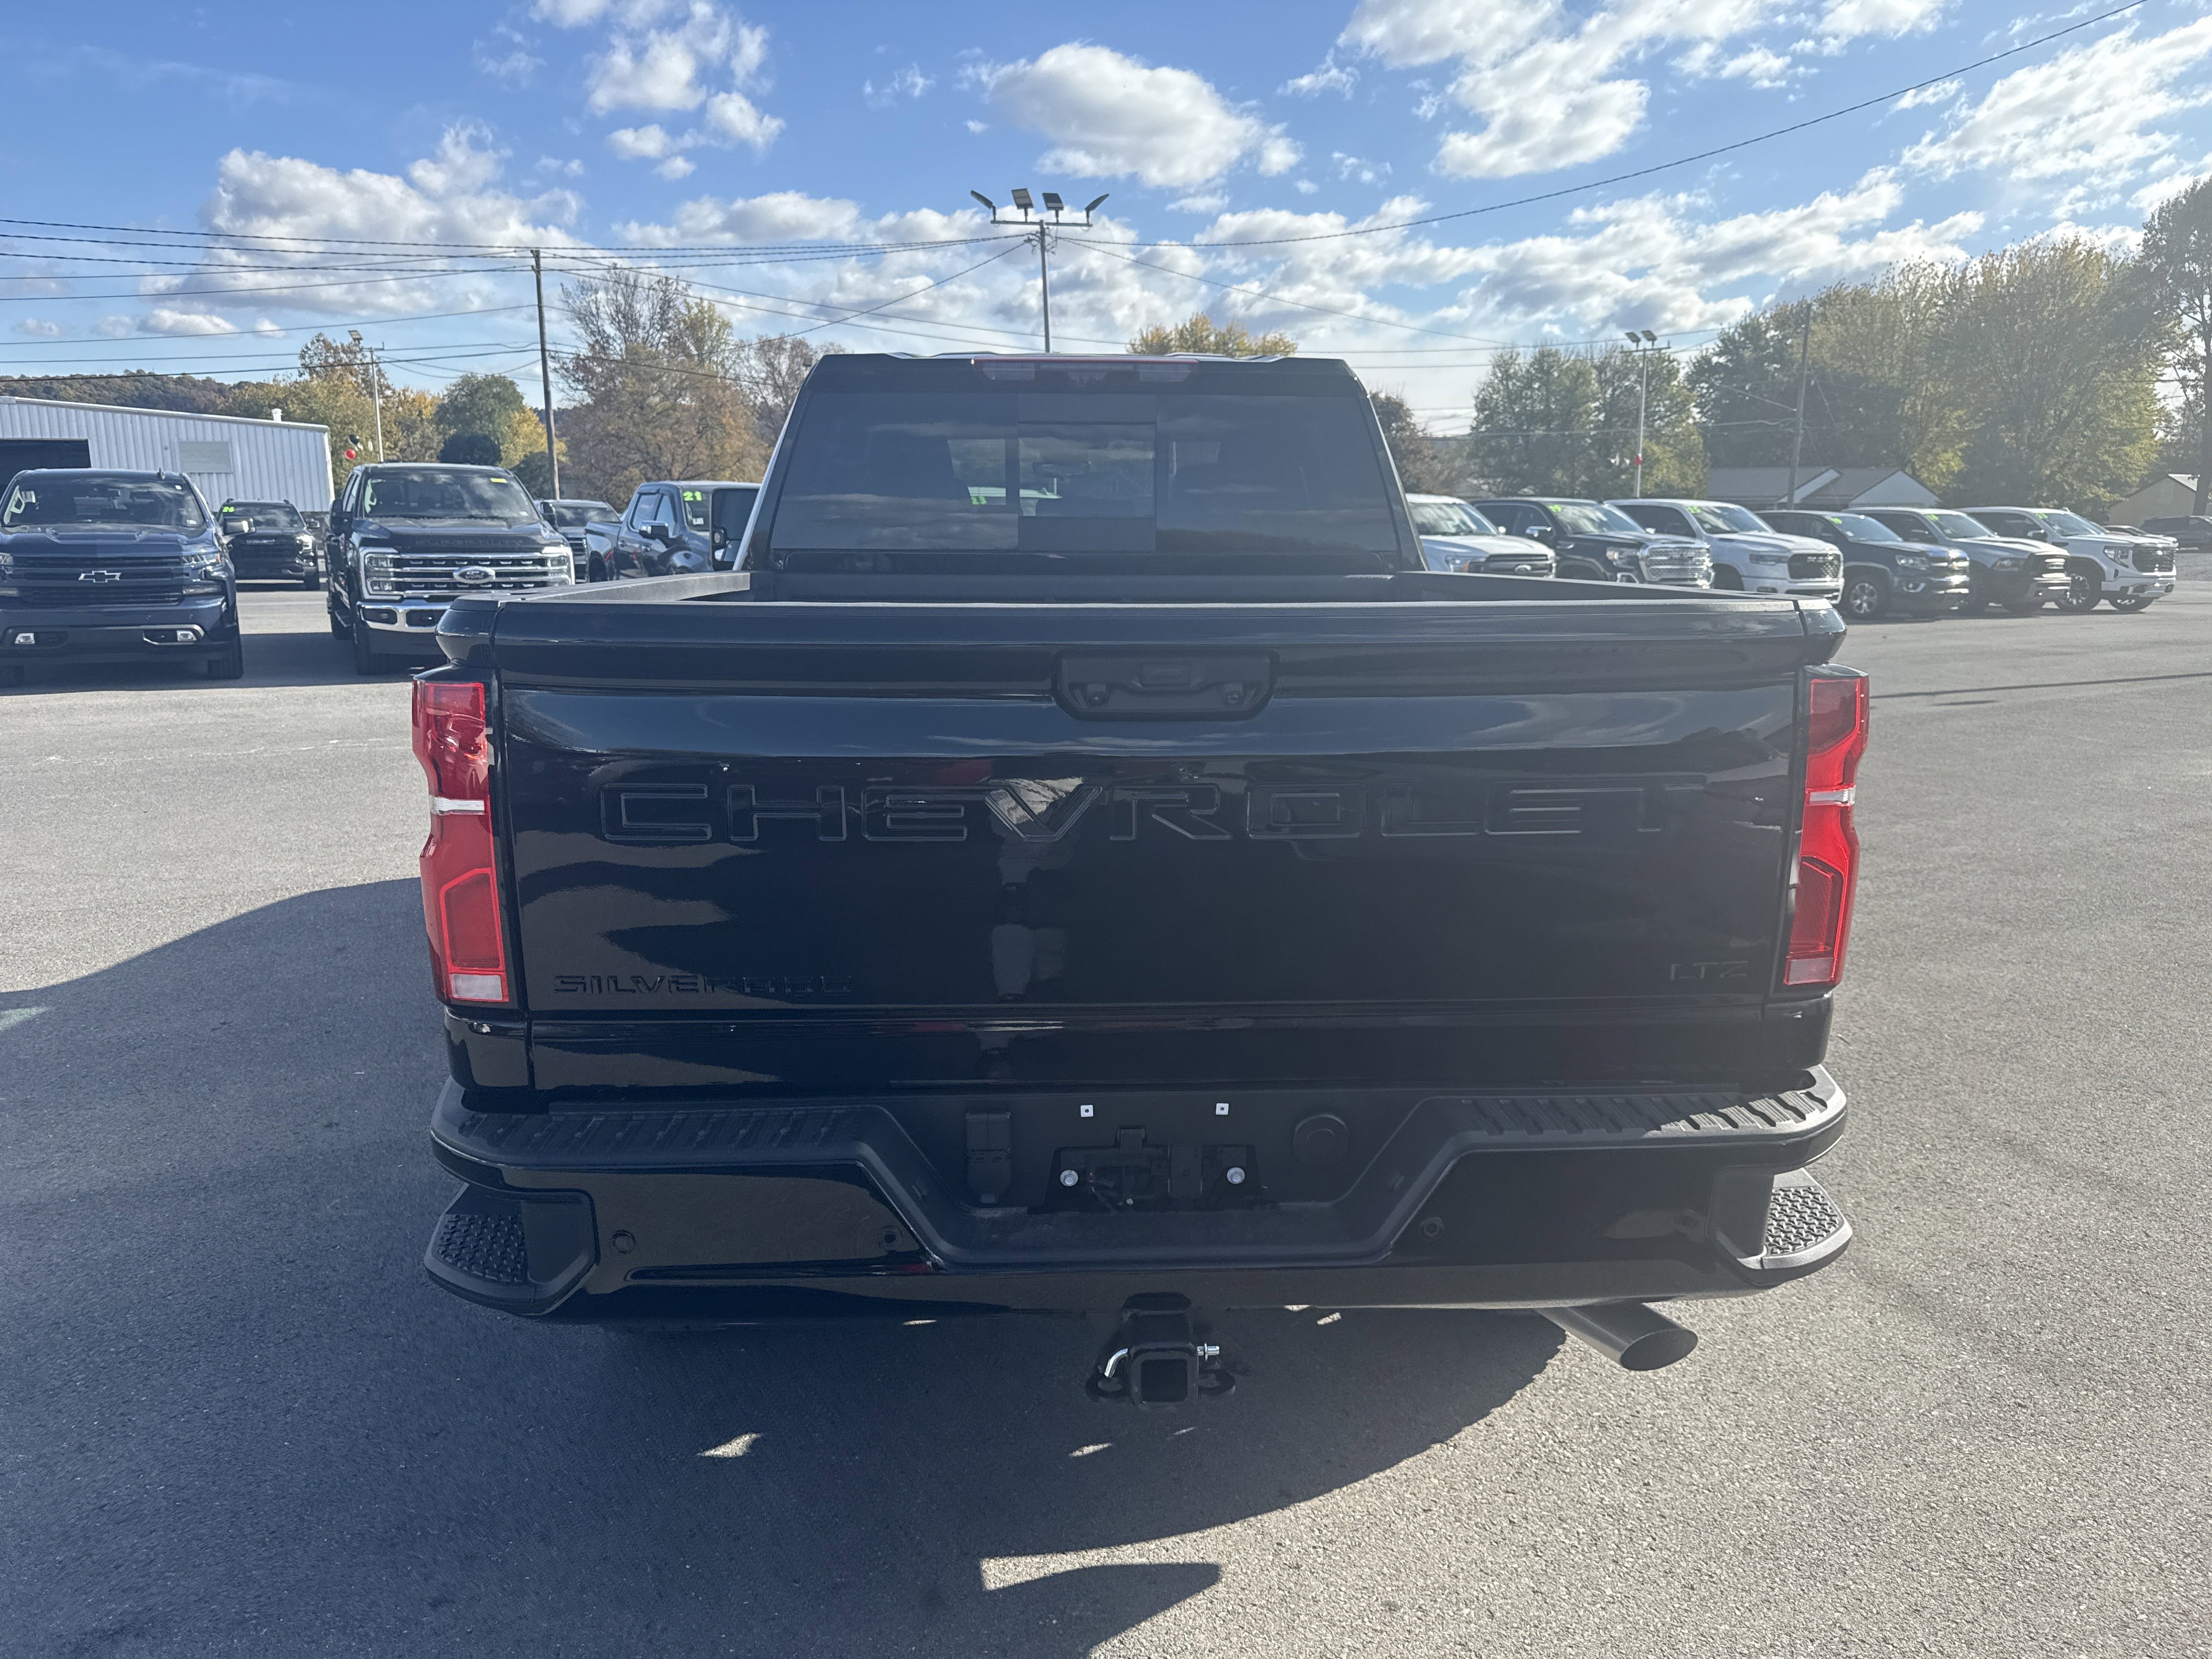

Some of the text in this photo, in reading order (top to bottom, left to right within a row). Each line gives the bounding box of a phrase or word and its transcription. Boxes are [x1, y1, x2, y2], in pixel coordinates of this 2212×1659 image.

[683, 491, 702, 501] 21
[466, 571, 485, 579] Ford
[599, 774, 1707, 841] CHEVROLET
[1671, 961, 1749, 980] LTZ
[554, 974, 852, 997] SILVERADO
